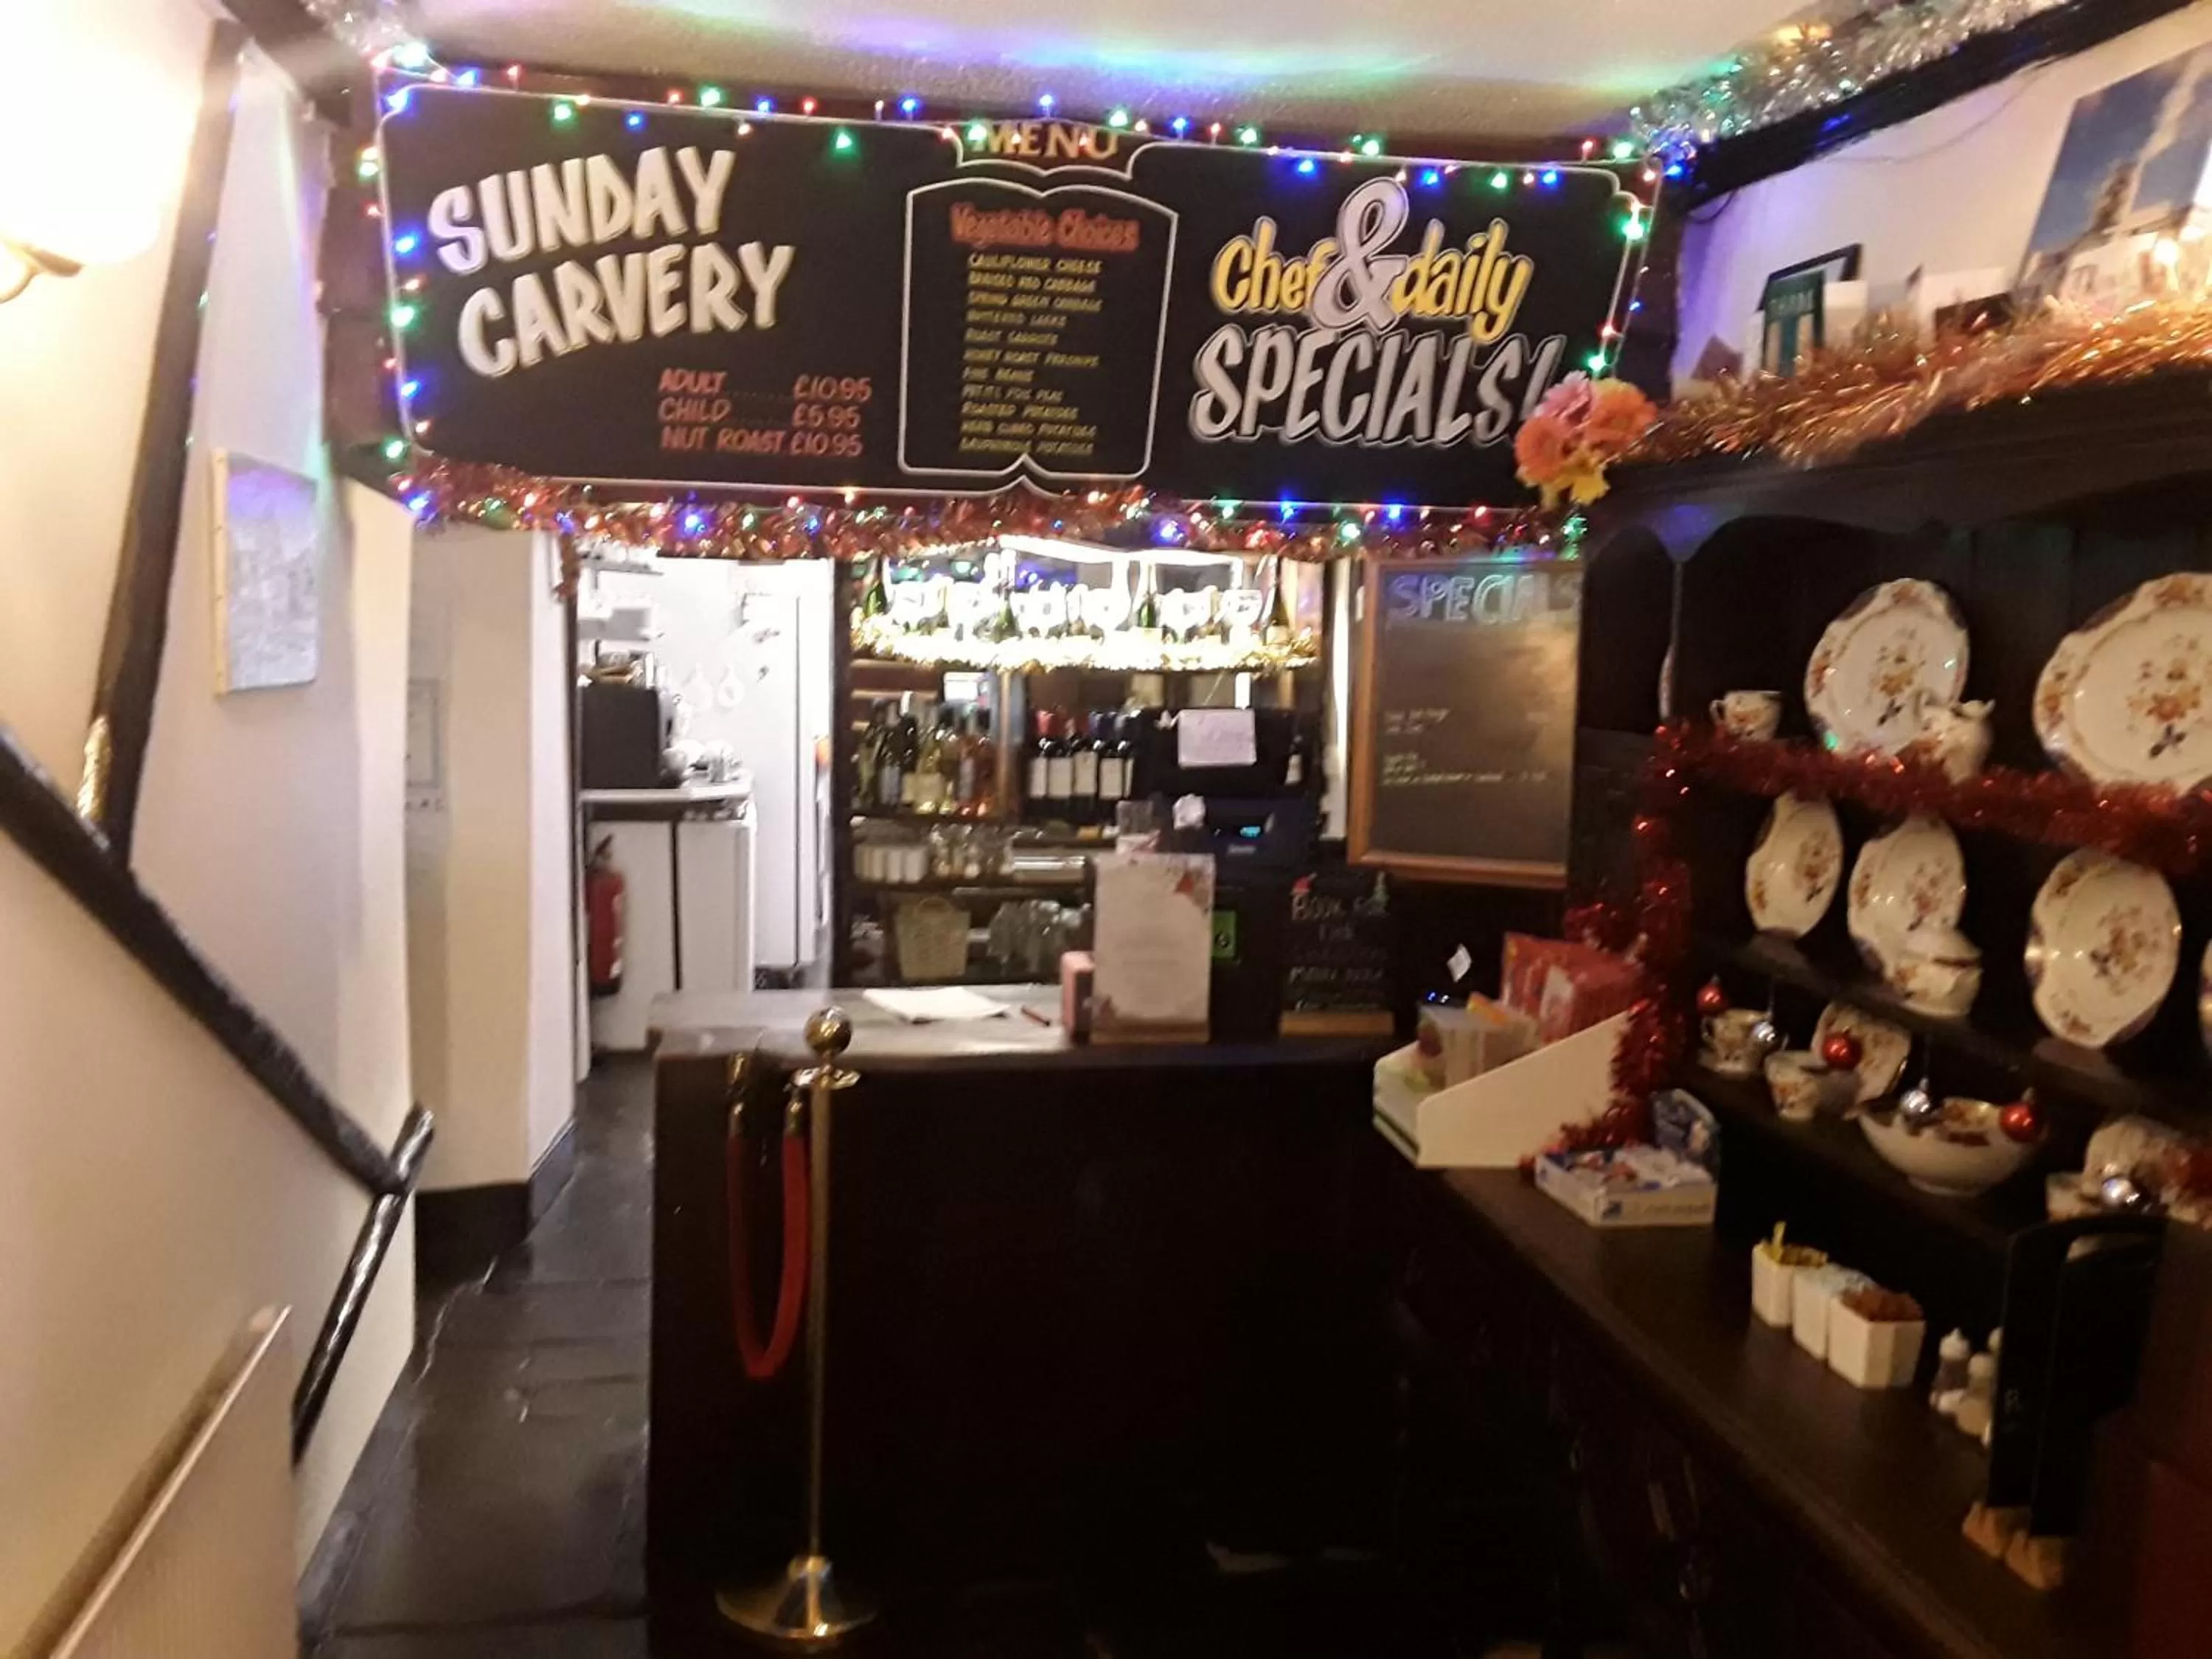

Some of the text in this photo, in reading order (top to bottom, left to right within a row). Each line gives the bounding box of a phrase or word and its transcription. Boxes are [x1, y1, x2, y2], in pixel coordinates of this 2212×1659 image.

[972, 120, 1119, 160] MENU
[428, 147, 736, 275] SUNDAY
[1212, 177, 1534, 344] Chef & daily
[457, 241, 796, 378] CARVERY
[658, 367, 728, 394] ADULT
[1189, 321, 1566, 447] SPECIALS!
[658, 397, 732, 422] CHILD
[660, 425, 709, 449] NUT
[716, 427, 786, 453] ROAST
[1386, 574, 1582, 627] SPECIALS
